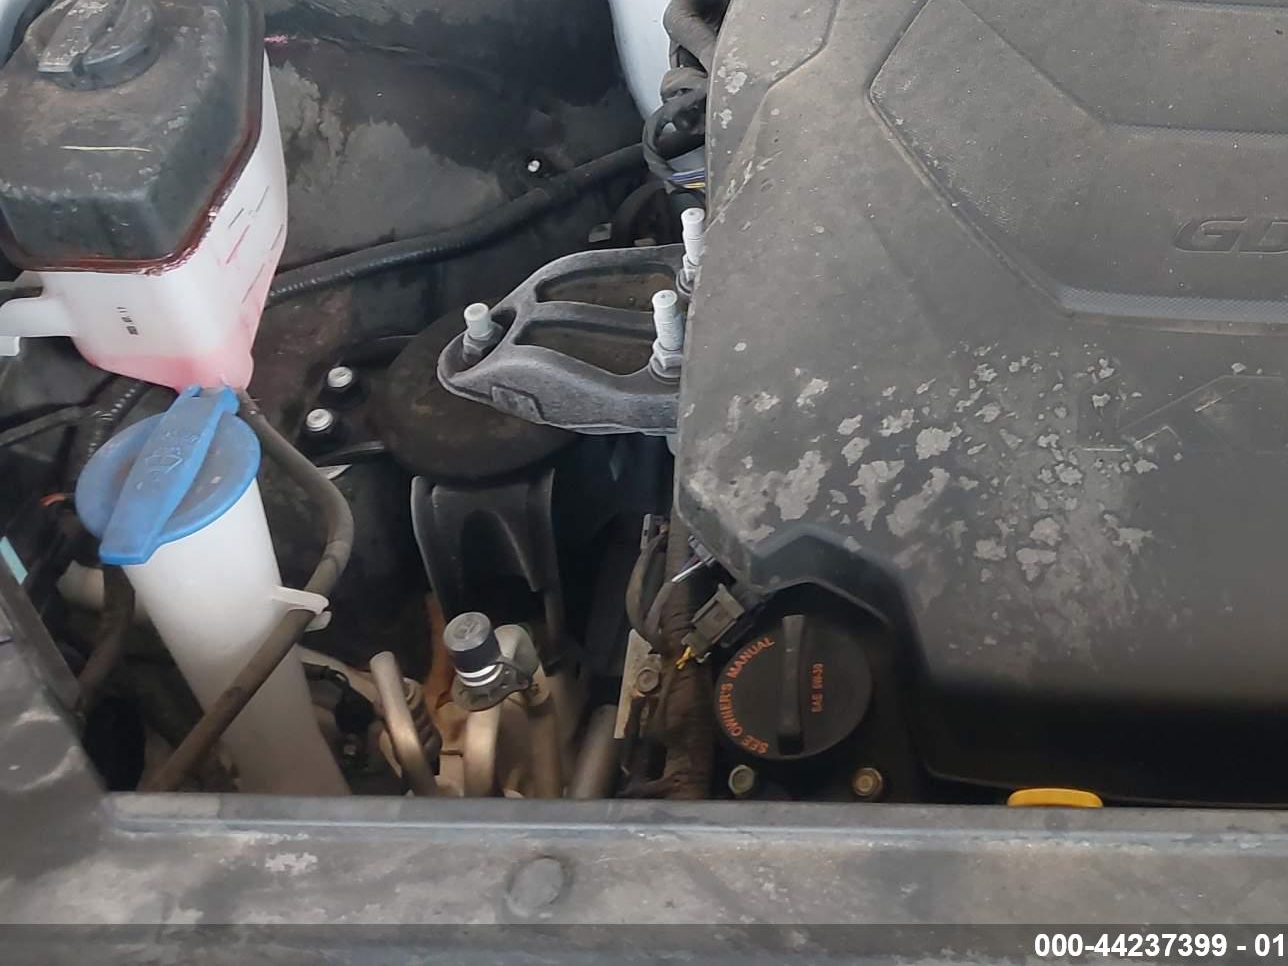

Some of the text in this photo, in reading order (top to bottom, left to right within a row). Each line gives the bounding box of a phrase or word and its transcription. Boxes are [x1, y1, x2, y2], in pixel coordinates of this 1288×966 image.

[719, 637, 775, 754] SEE OWNER'S MANUAL
[811, 694, 823, 713] SAE
